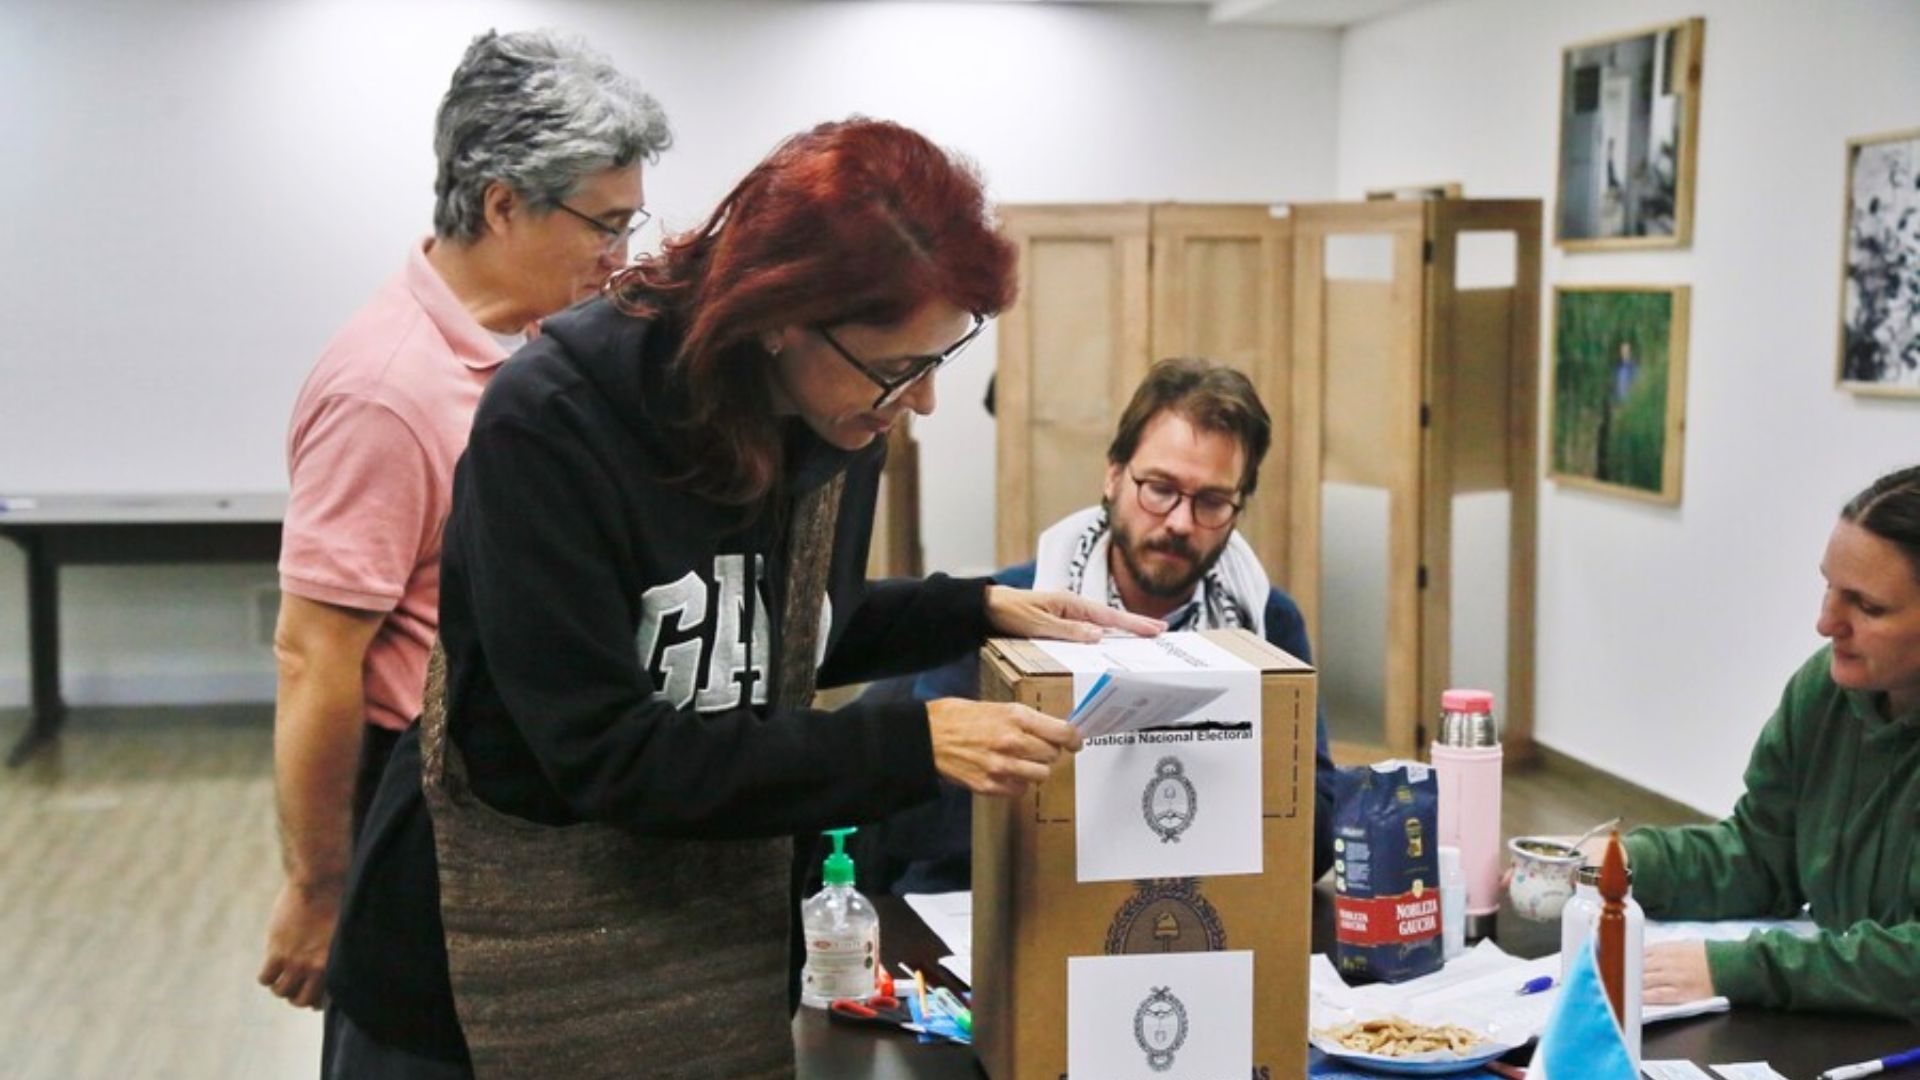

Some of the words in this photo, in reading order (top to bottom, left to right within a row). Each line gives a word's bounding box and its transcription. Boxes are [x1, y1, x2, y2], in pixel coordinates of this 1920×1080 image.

[636, 554, 833, 712] GA
[1085, 733, 1135, 746] Justicia
[1138, 730, 1193, 744] Nacional
[1197, 727, 1253, 741] Electoral
[1396, 898, 1438, 920] NOBLEZA
[1399, 915, 1437, 935] GAUCHA
